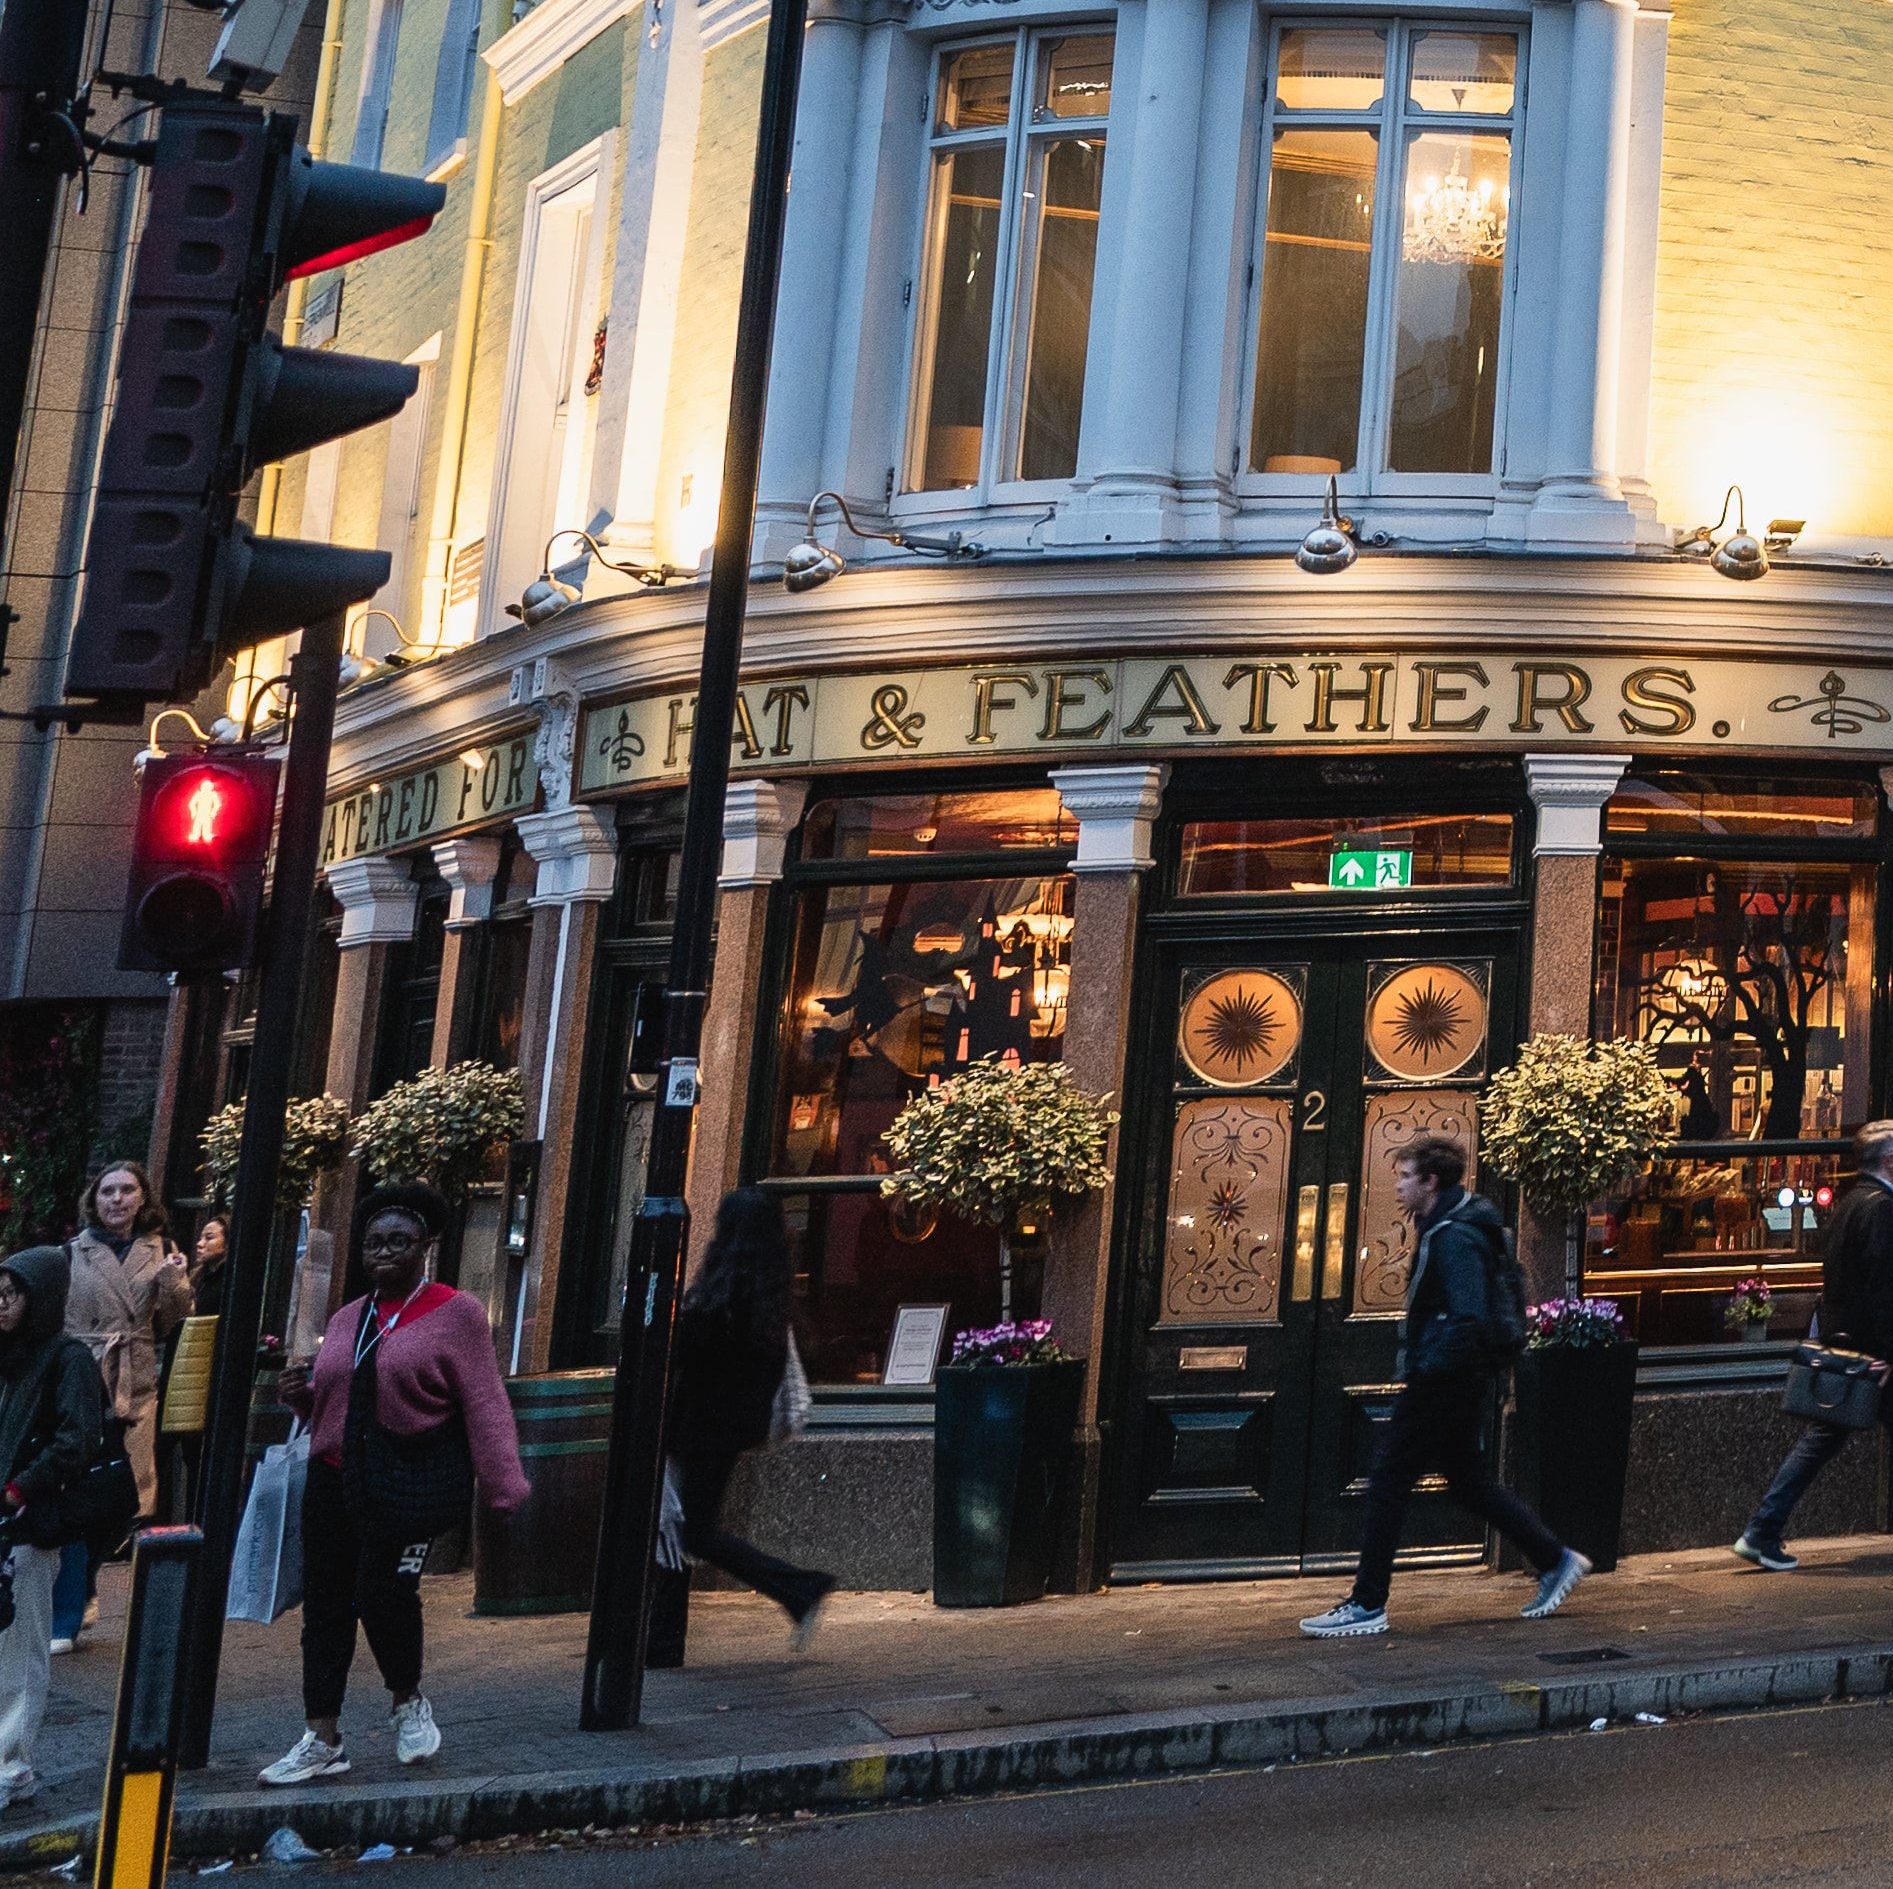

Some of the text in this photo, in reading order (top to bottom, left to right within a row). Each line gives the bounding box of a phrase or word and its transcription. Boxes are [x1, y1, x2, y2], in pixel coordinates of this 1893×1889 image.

[859, 683, 927, 751] &
[322, 738, 528, 864] ATERED FOR
[1302, 1090, 1326, 1130] 2
